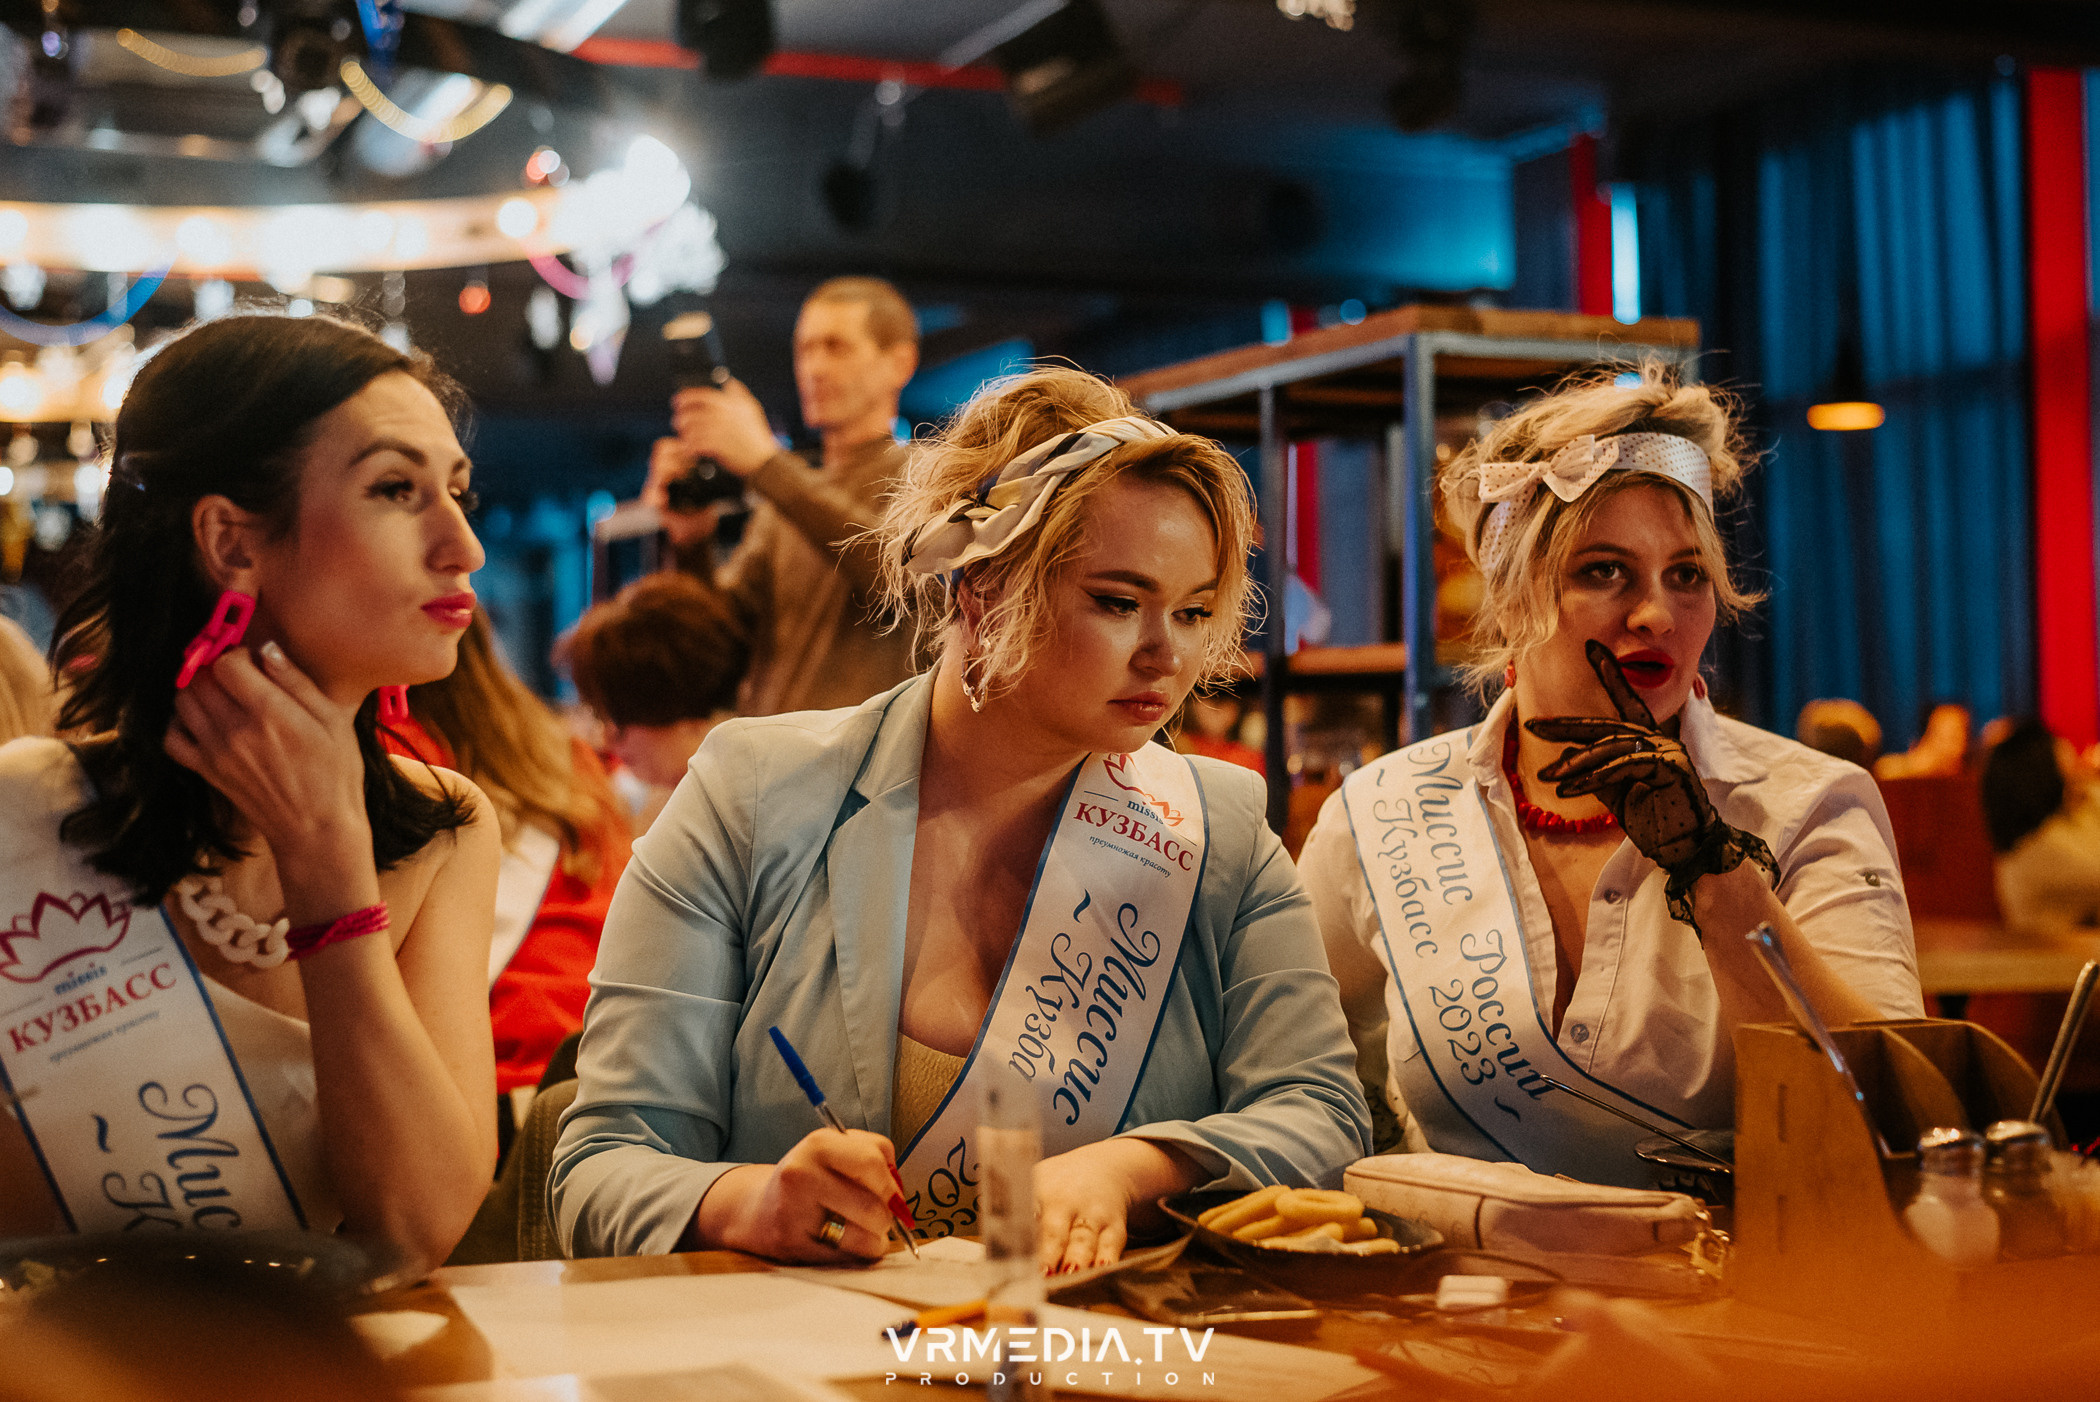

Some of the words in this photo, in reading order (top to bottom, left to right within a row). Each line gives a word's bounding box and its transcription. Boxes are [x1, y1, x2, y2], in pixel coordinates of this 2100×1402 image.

[1073, 801, 1195, 872] КУЗБАСС
[1139, 856, 1172, 878] красоту
[1407, 741, 1474, 906] Миссис
[7, 961, 177, 1053] КУЗБАСС
[1007, 932, 1093, 1084] Кузба
[1053, 902, 1161, 1126] Миссис
[1372, 798, 1439, 959] Кузбасс
[1427, 978, 1497, 1086] 2023
[138, 1081, 243, 1230] Мис
[905, 1135, 982, 1222] 202
